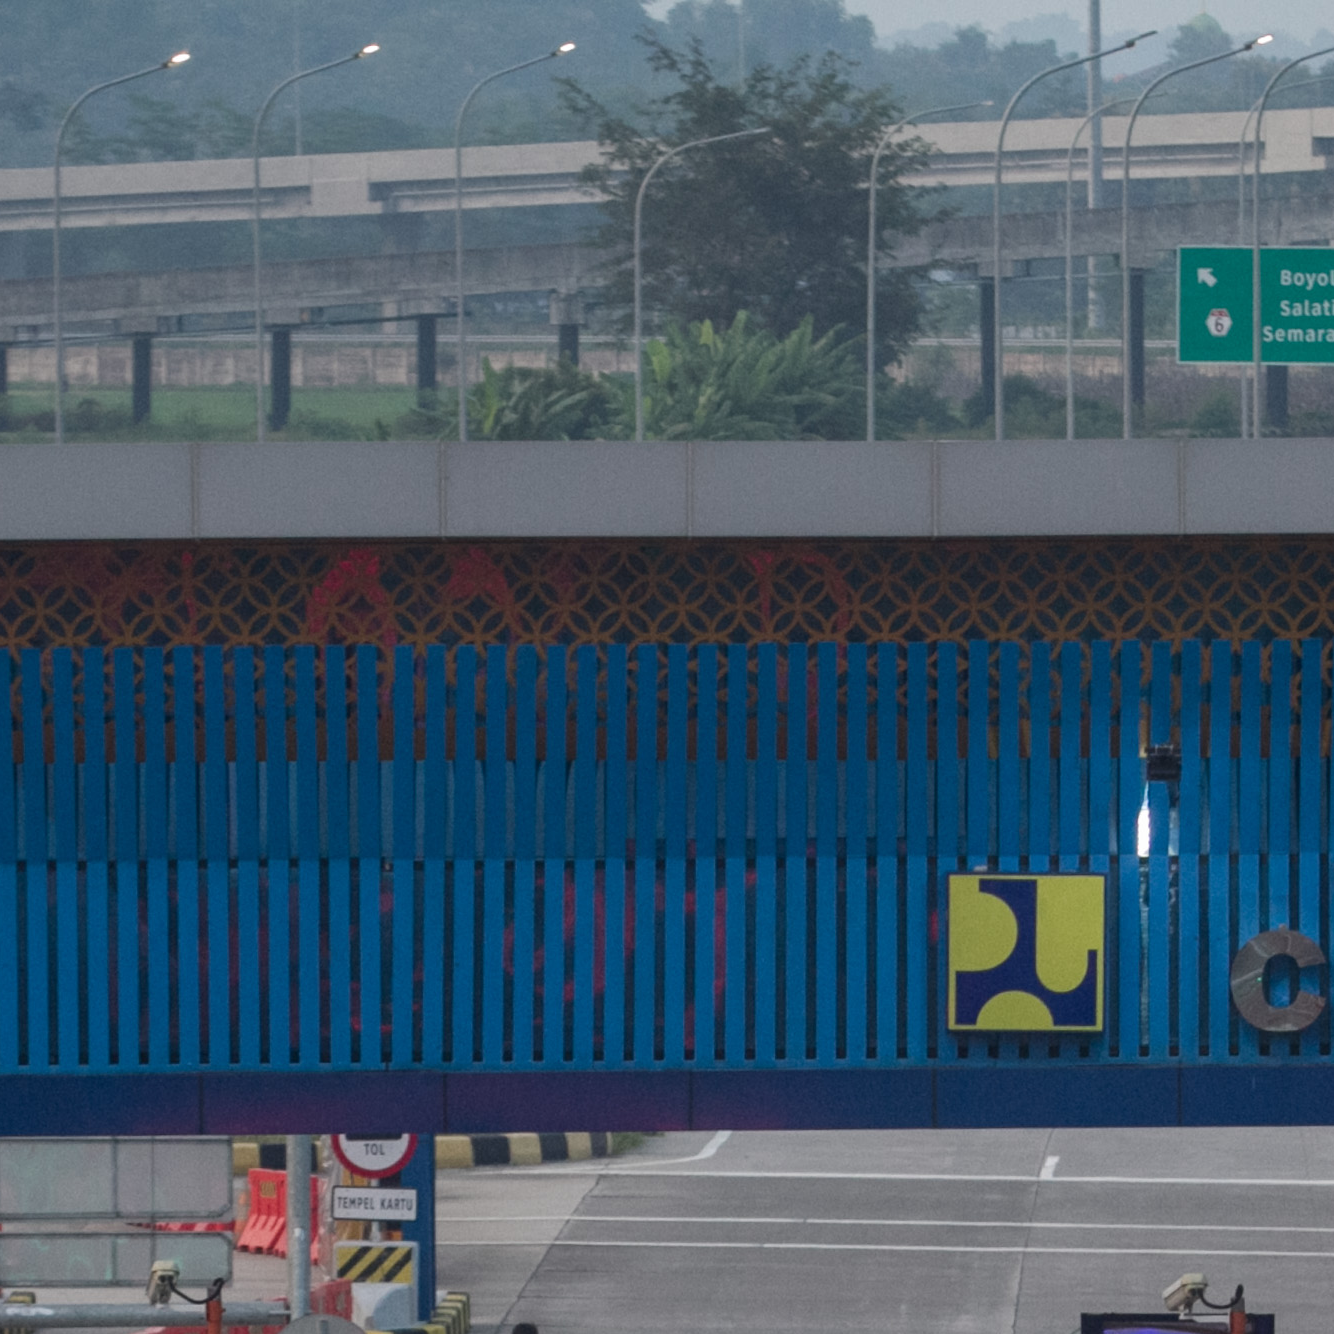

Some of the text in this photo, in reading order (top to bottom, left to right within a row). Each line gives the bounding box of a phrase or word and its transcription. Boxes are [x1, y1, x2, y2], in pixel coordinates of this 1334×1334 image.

[1214, 317, 1224, 332] 6
[363, 1143, 385, 1156] TOL
[337, 1196, 414, 1212] TEMPEL KARTU
